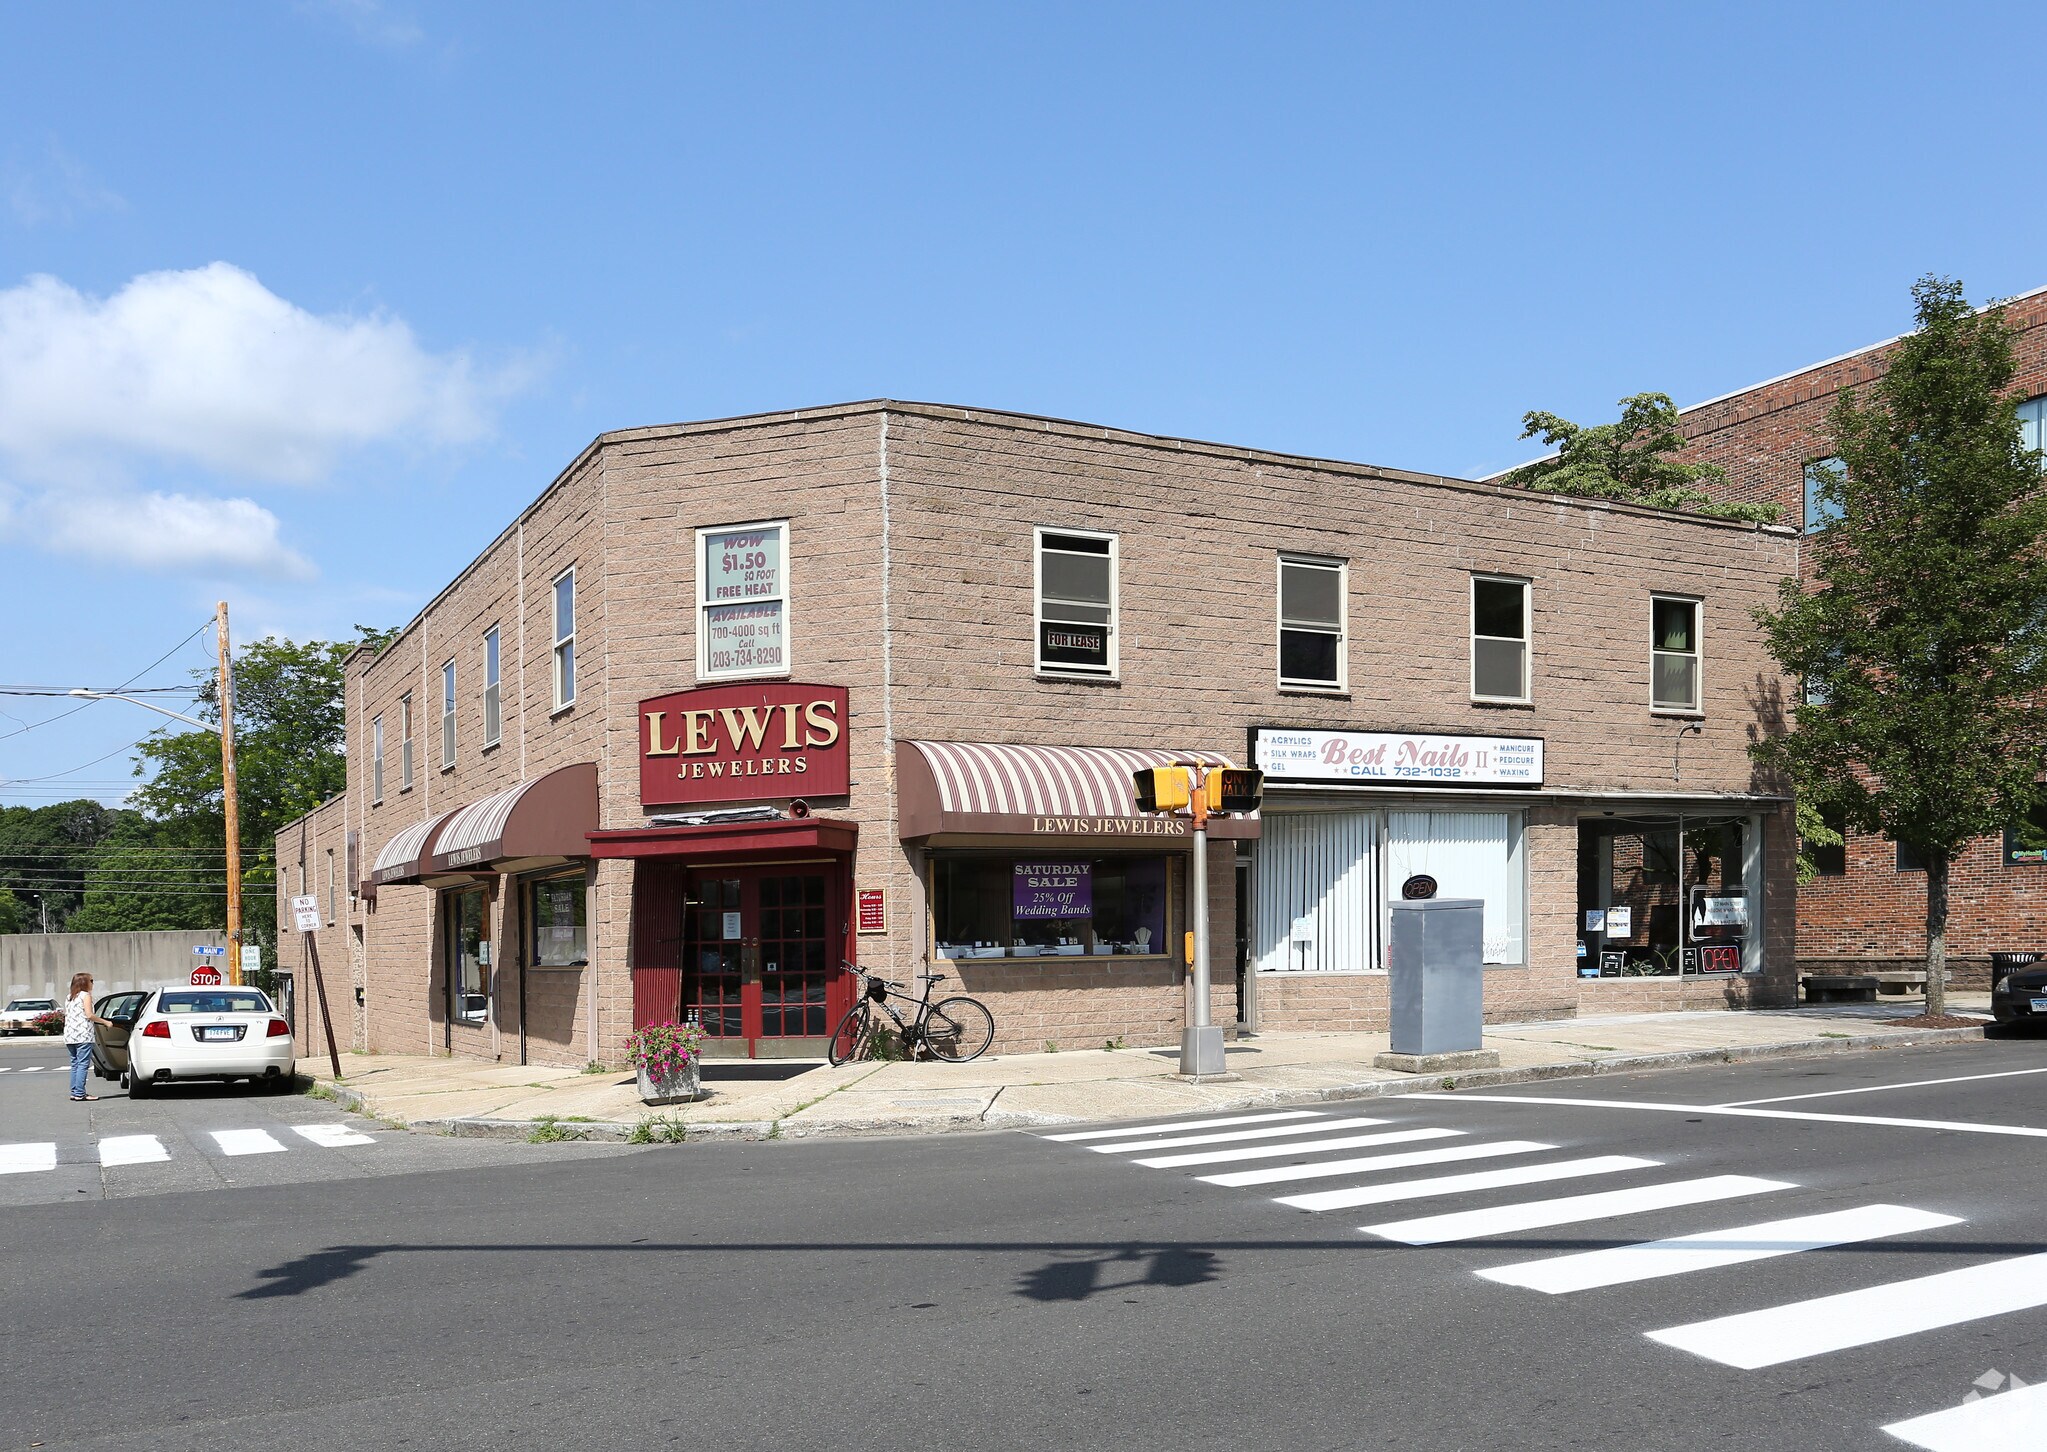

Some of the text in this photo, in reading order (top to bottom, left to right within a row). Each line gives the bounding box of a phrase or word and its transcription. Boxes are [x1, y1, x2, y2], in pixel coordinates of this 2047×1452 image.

[724, 535, 765, 549] WOW
[722, 551, 766, 574] $1.50
[744, 569, 776, 581] SQ FOOT
[717, 582, 773, 598] FREE HEAT
[712, 605, 779, 623] AVAILABLE
[712, 622, 780, 639] 700-4000 sq ft
[739, 639, 754, 648] Call
[1049, 633, 1099, 648] FOR LEASE
[712, 646, 781, 668] 203-734-8290
[644, 699, 839, 756] LEWIS
[1271, 736, 1312, 745] ACRYLICS
[1271, 749, 1317, 758] SILK WRAPS
[1320, 738, 1489, 768] Best Nails II
[1500, 744, 1534, 752] MANICURE
[1500, 756, 1534, 764] PEDICURE
[677, 757, 808, 779] JEWELERS
[1271, 763, 1286, 771] GEL
[1351, 766, 1461, 777] CALL 732-1032
[1032, 817, 1185, 835] LEWIS JEWELERS
[447, 847, 482, 867] LEWIS JEWELERS
[1015, 864, 1090, 875] SATURDAY
[1028, 877, 1078, 888] SALE
[1405, 881, 1434, 895] OPEN
[300, 898, 309, 906] NO
[1033, 892, 1075, 904] 25% Off
[554, 903, 570, 913] SALE
[1016, 904, 1091, 917] Wedding Bands
[1703, 948, 1740, 970] OPEN
[192, 973, 220, 985] STOP
